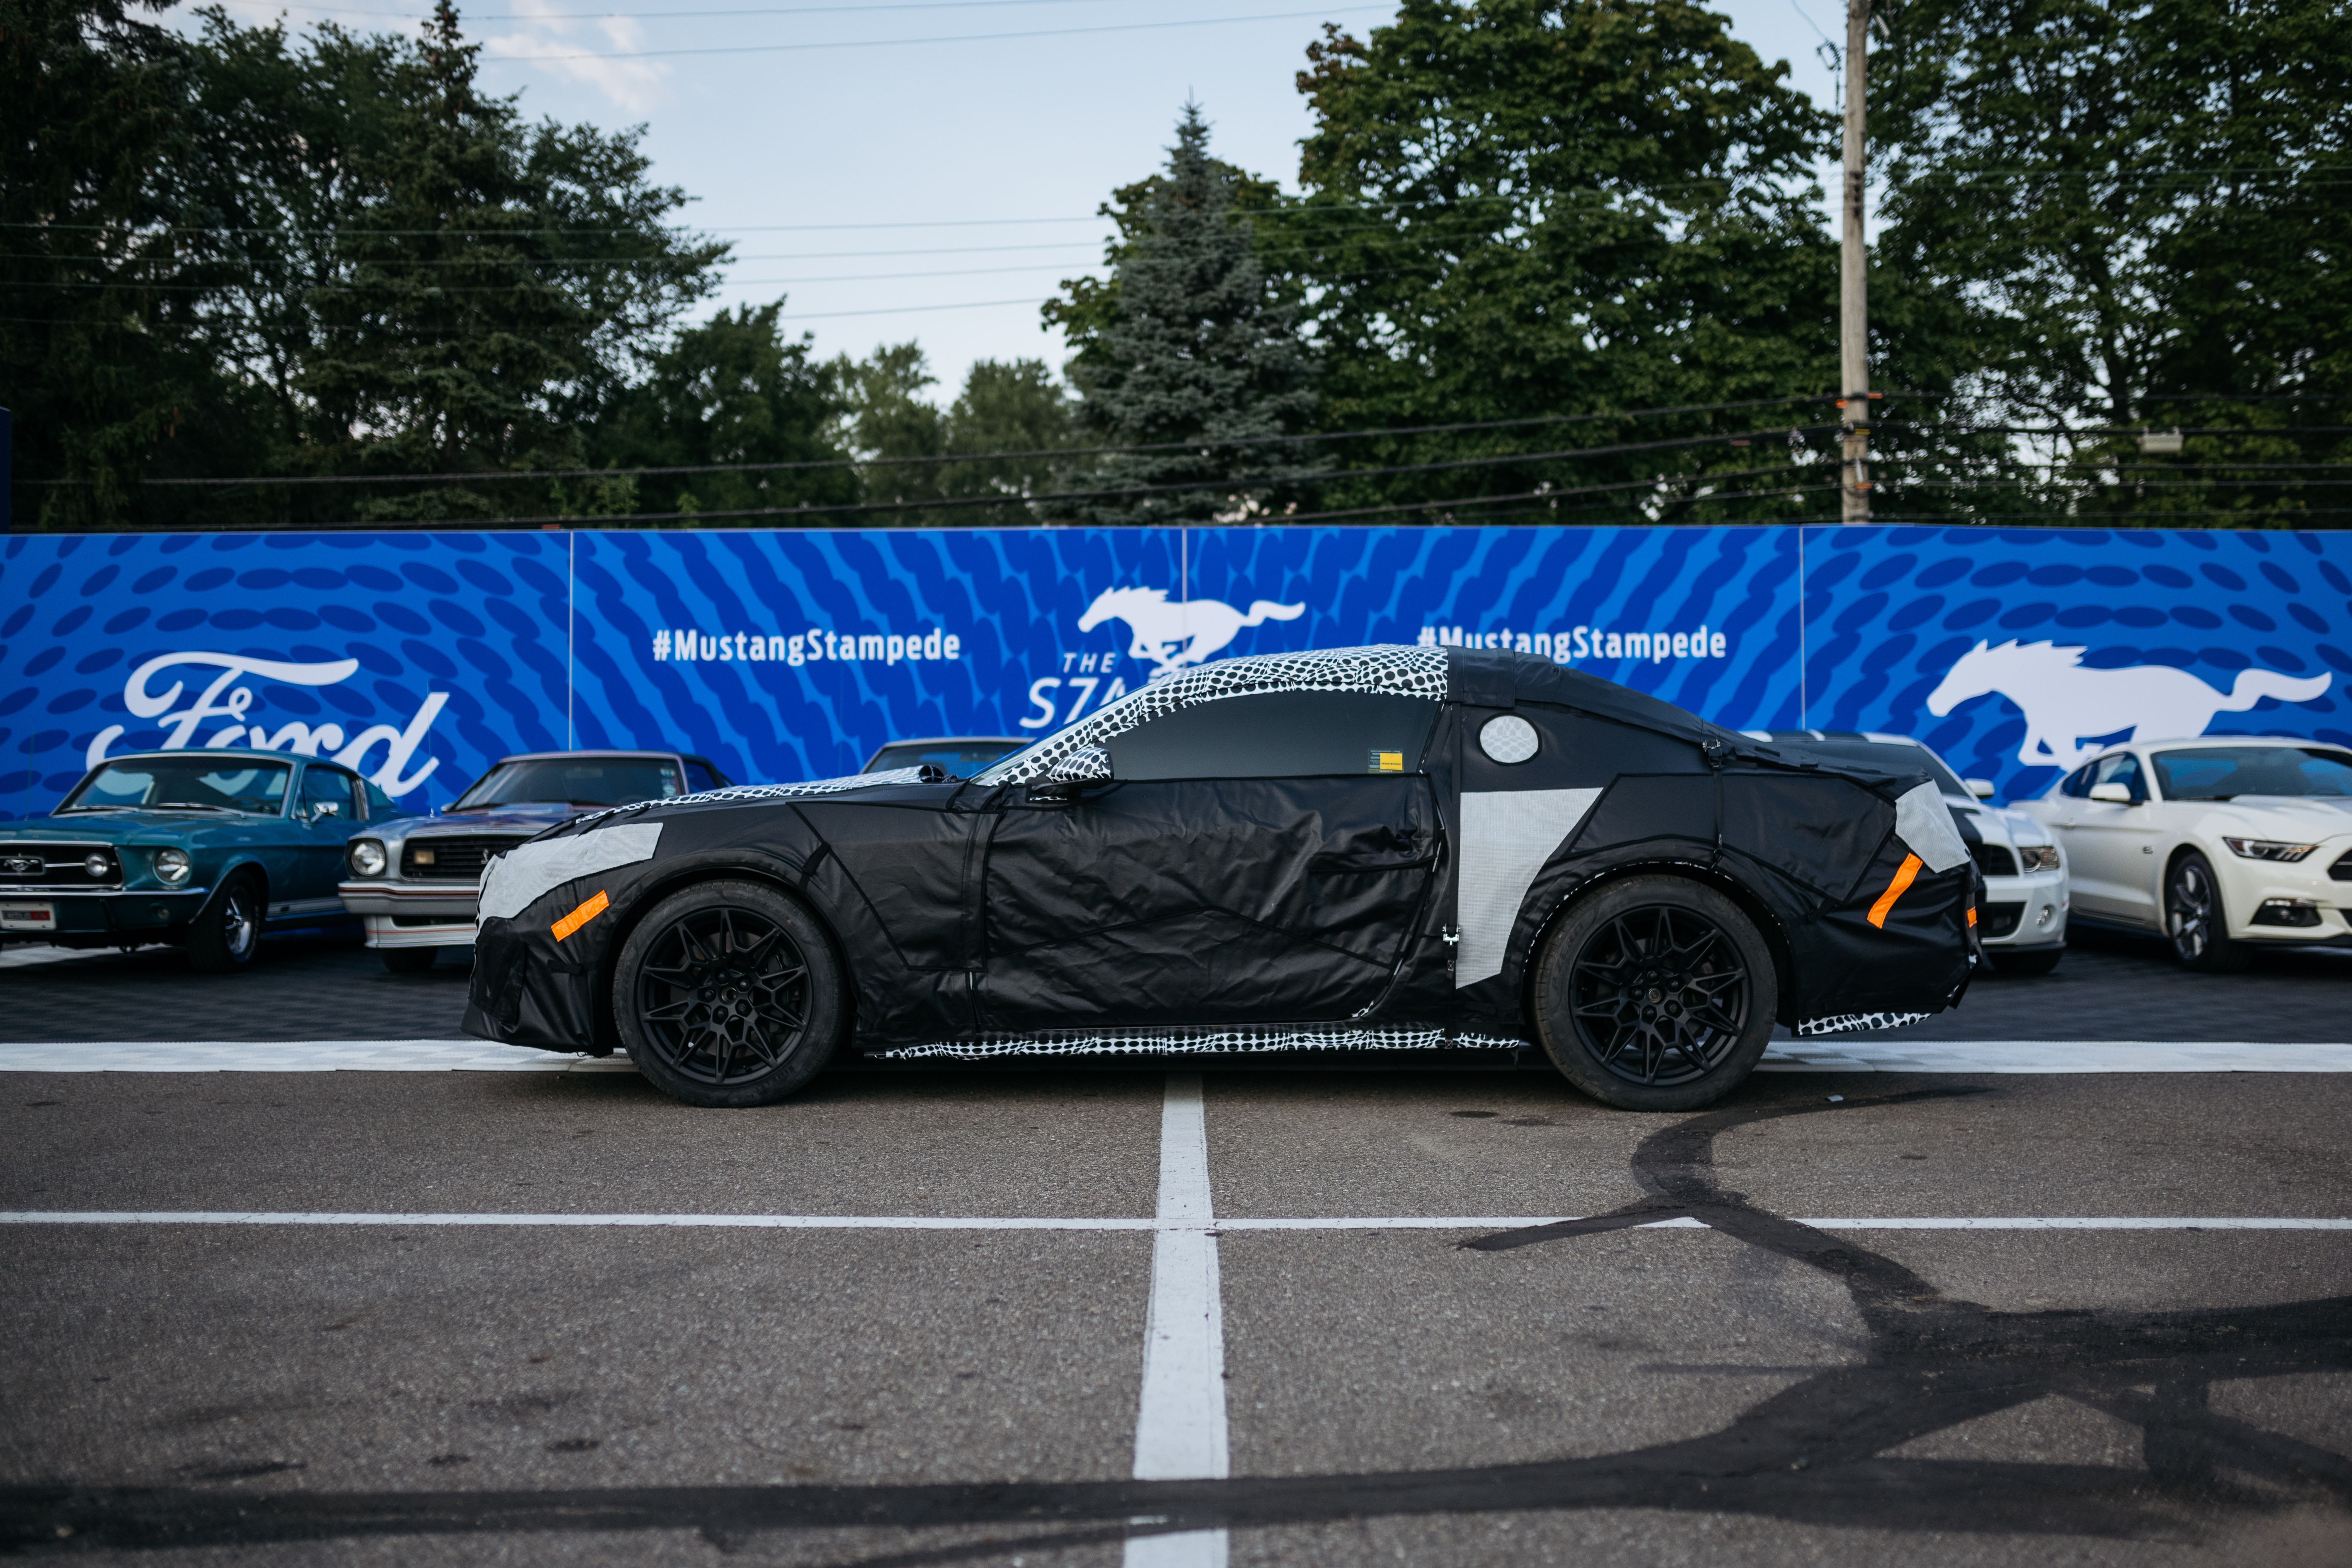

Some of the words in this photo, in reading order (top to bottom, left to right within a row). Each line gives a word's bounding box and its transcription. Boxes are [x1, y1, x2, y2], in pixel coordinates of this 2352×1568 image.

[653, 628, 960, 666] #MustangStampede
[1063, 653, 1115, 673] THE
[1418, 625, 1726, 664] #MustangStampede
[1555, 923, 1584, 967] ZERO
